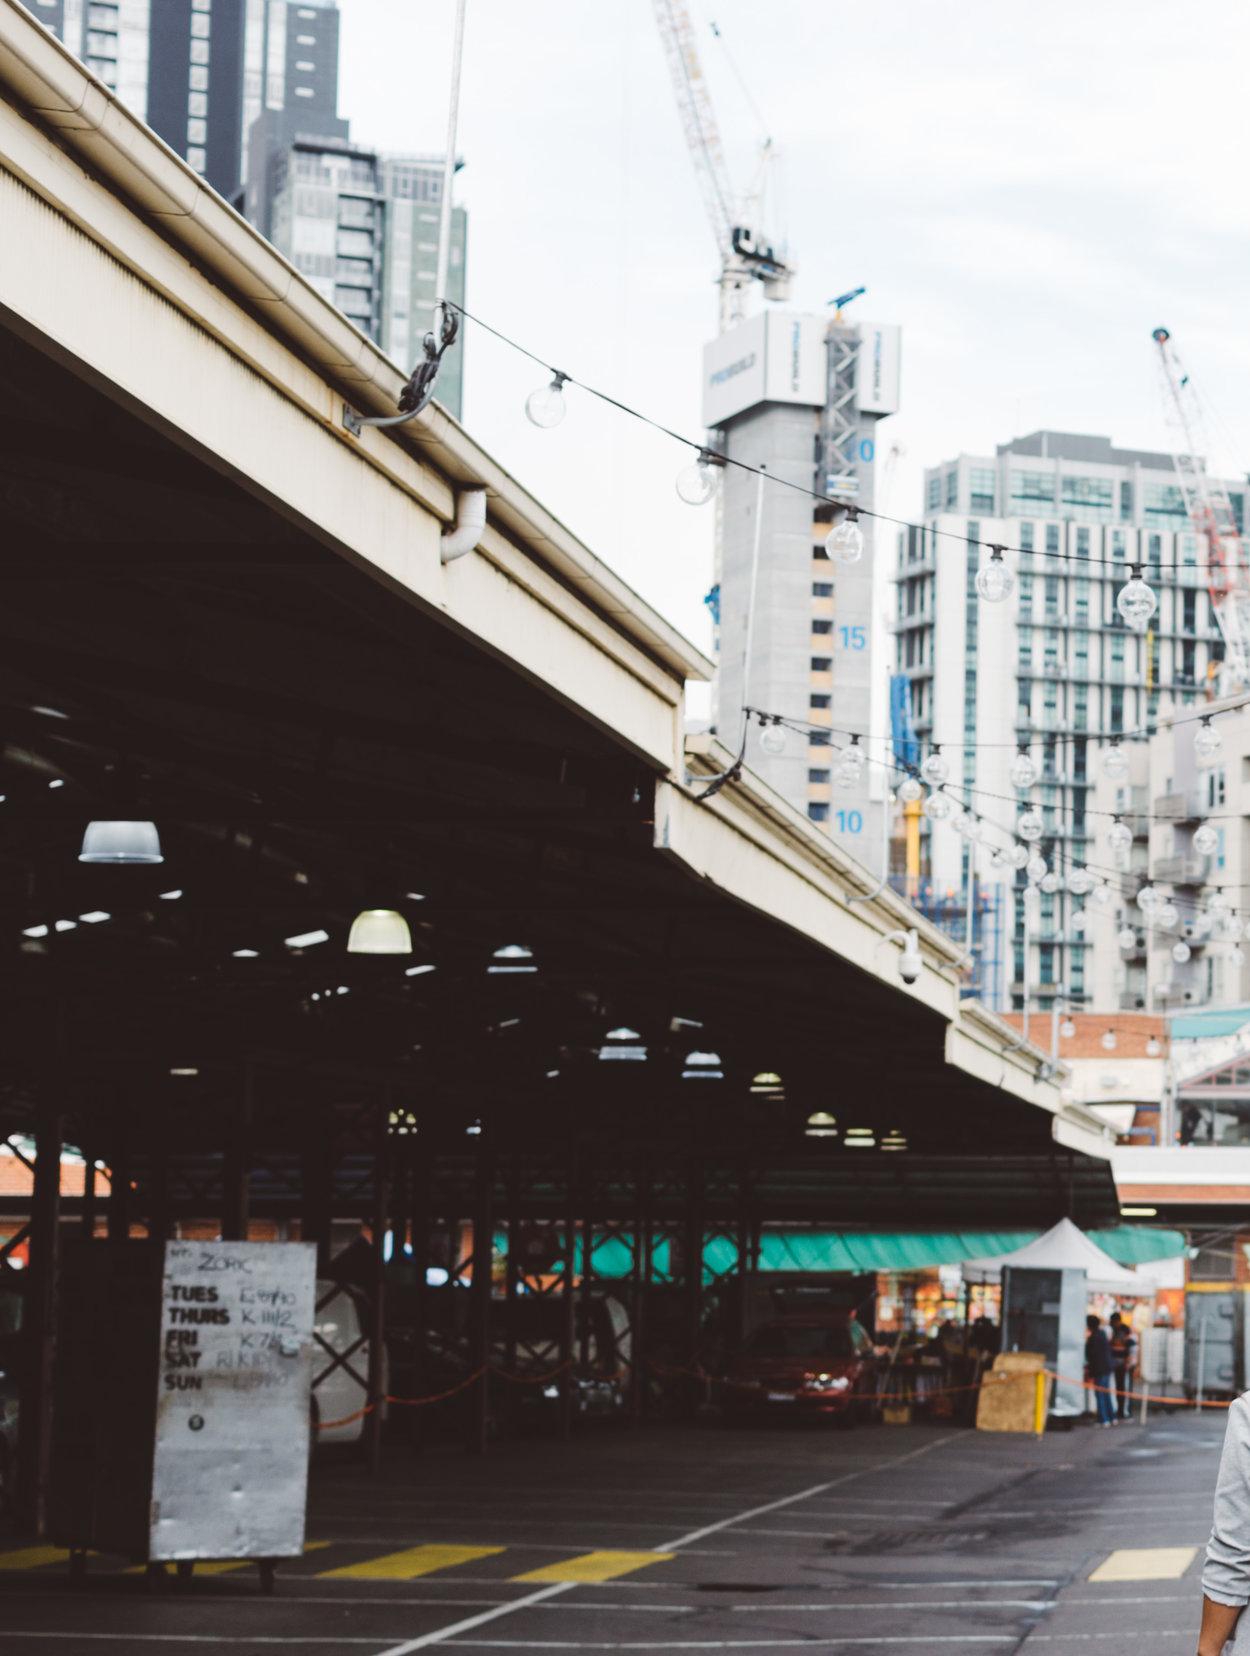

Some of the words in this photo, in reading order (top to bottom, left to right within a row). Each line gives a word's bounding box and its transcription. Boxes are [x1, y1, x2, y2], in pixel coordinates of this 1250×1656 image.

[838, 626, 866, 650] 15
[835, 811, 863, 834] 10
[171, 1285, 219, 1303] TUES
[168, 1307, 230, 1325] THURS
[166, 1330, 198, 1347] FRI
[165, 1351, 202, 1369] SAT
[164, 1374, 203, 1391] SUN
